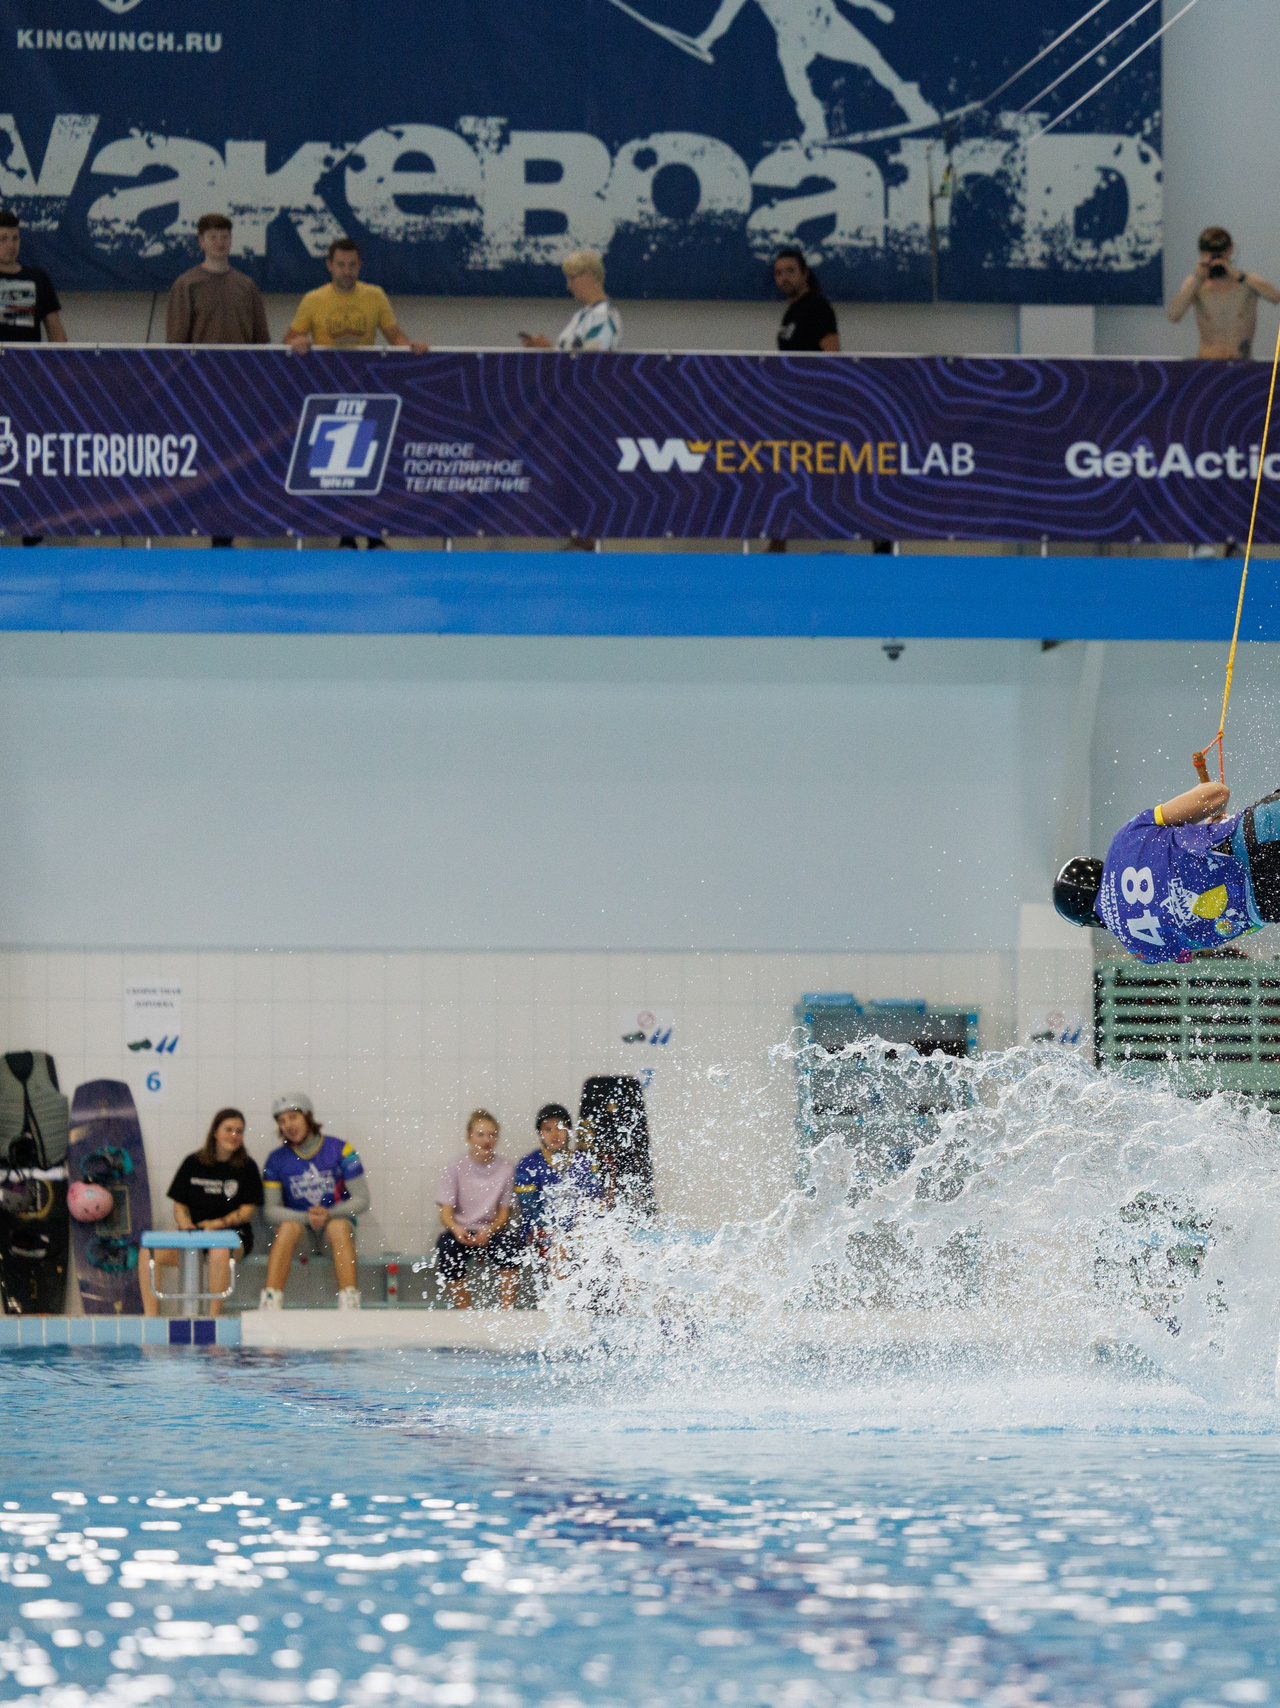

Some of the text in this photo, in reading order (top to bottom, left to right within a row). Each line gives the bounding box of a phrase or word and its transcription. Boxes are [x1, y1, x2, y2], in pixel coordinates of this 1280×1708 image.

[16, 28, 223, 53] KINGWINCH.RU
[25, 433, 198, 478] PETERBURG2
[403, 441, 476, 459] ПЕРВОЕ
[715, 440, 976, 477] EXTREMELAB
[403, 458, 525, 476] ПОПУЛЯРНОЕ
[405, 475, 534, 495] ТЕЛЕВИДЕНИЕ
[1121, 866, 1166, 946] 48
[146, 1071, 162, 1092] 6
